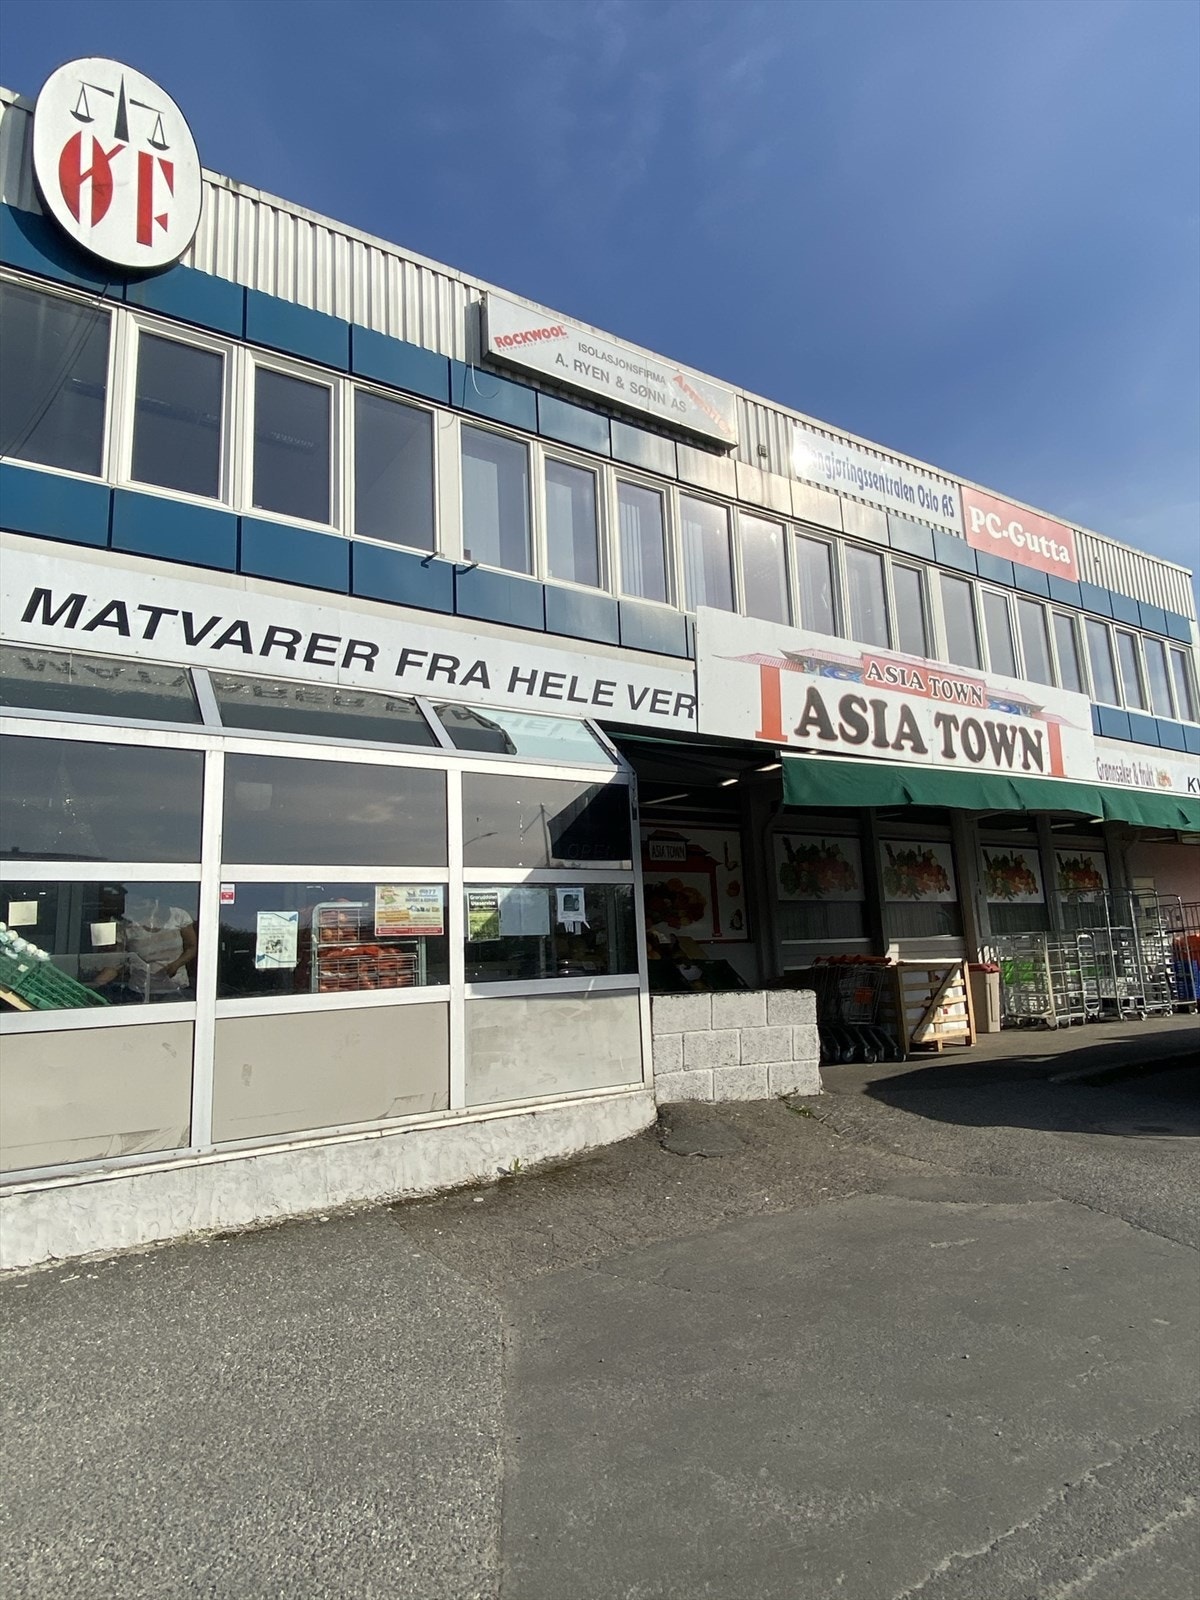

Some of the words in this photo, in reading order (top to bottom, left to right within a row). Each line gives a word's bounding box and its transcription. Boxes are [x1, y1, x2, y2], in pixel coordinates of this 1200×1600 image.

[493, 325, 567, 348] ROCKWOOL
[555, 353, 569, 369] A.
[573, 360, 610, 384] RYEN
[616, 375, 625, 390] &
[629, 382, 666, 406] SØNN
[671, 398, 687, 414] AS
[578, 342, 666, 385] ISOLASJONSFIRMA
[917, 484, 939, 513] Oslo
[942, 494, 954, 518] AS
[968, 506, 1071, 565] PC-Gutta
[20, 587, 380, 673] MATVARER
[395, 647, 492, 690] FRA
[507, 666, 618, 709] HELE
[627, 684, 696, 719] VER
[865, 660, 926, 692] ASIA
[927, 677, 984, 706] TOWN
[794, 686, 929, 755] ASIA
[934, 712, 1044, 774] TOWN
